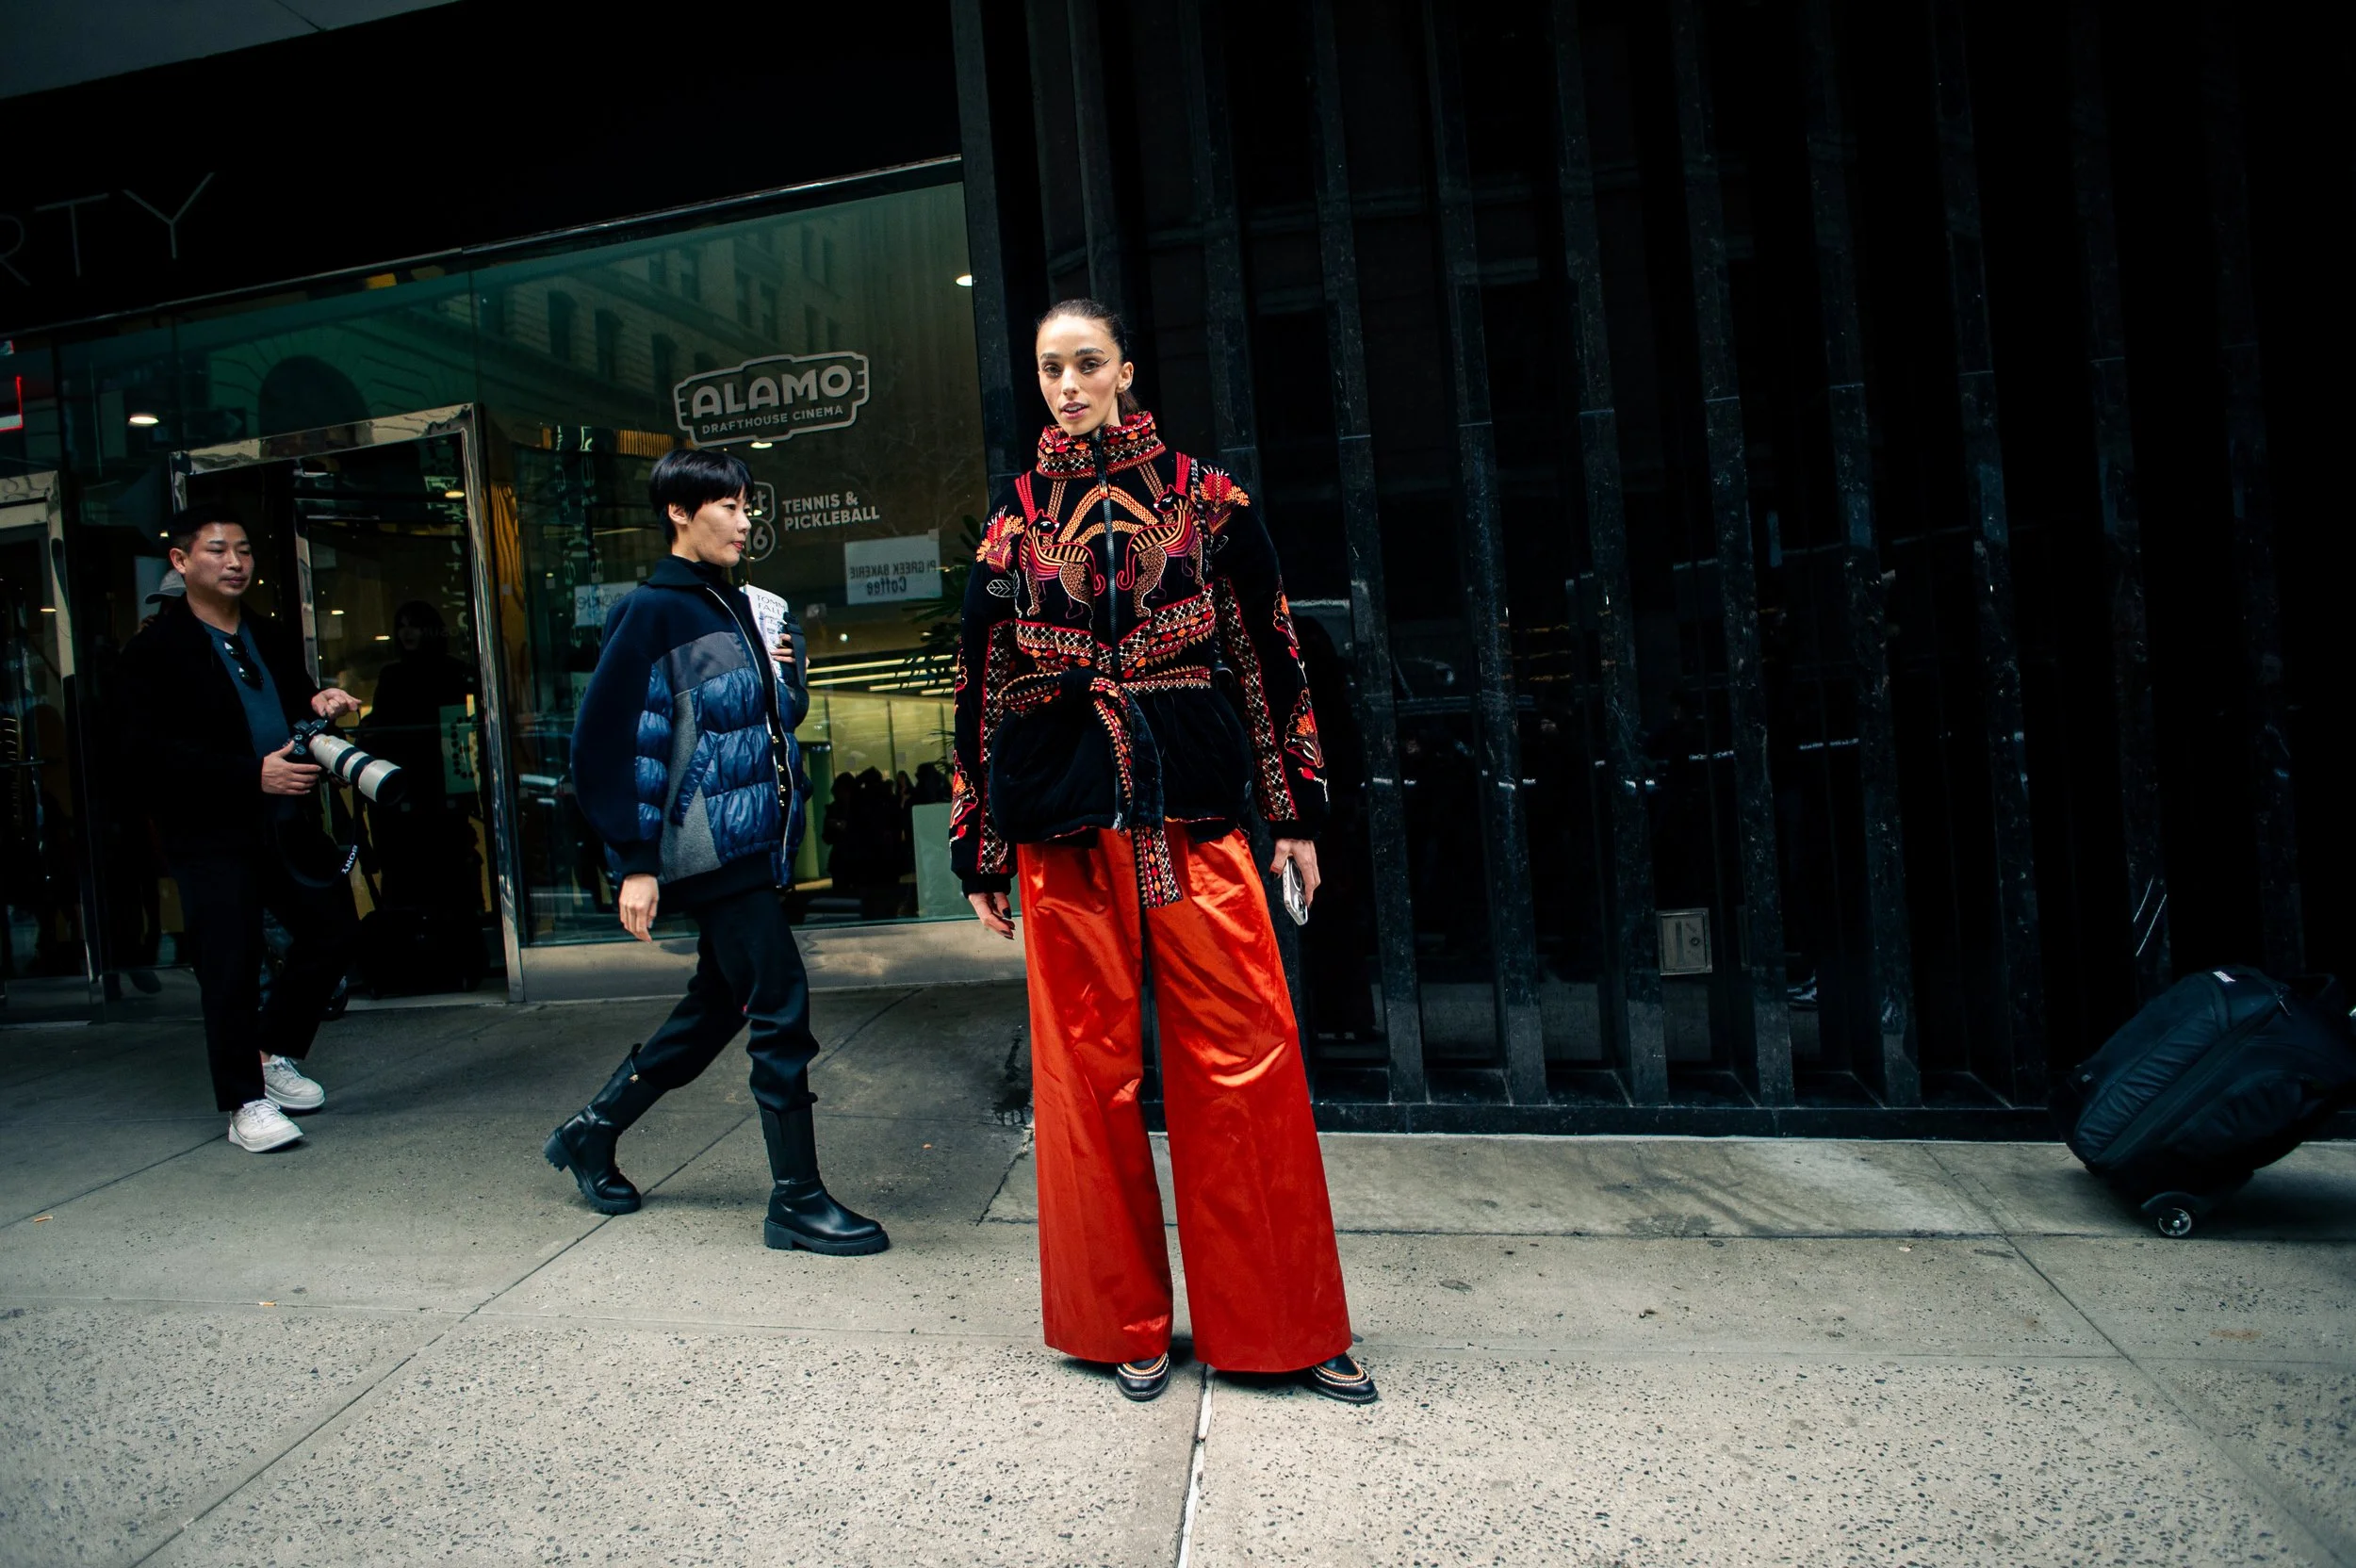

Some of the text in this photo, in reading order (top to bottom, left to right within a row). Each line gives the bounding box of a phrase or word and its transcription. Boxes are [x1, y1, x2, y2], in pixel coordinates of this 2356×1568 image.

[693, 365, 852, 418] ALAMO
[702, 405, 843, 434] DRAFTHOUSE CINEMA
[782, 494, 841, 514] TENNIS
[845, 491, 859, 505] &
[784, 506, 880, 531] PICKLEBALL
